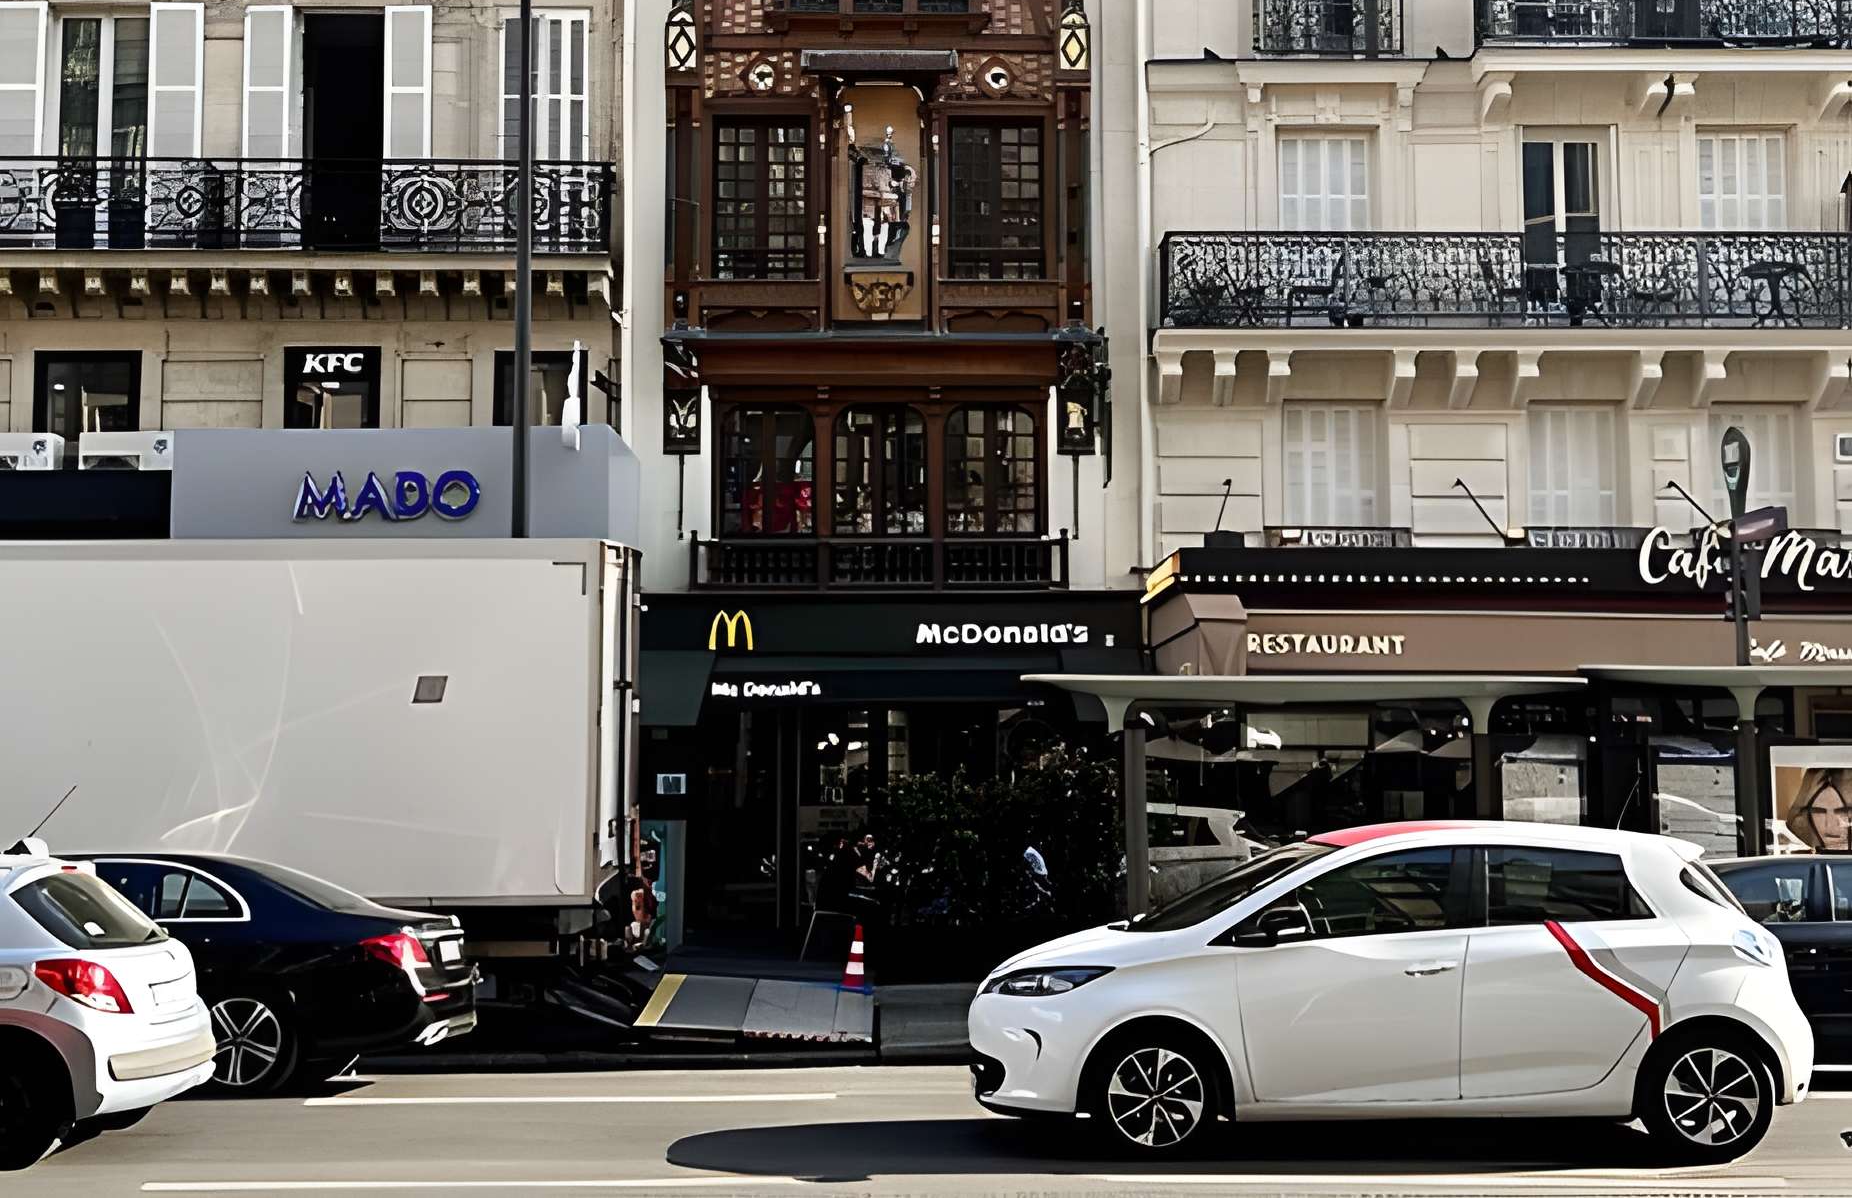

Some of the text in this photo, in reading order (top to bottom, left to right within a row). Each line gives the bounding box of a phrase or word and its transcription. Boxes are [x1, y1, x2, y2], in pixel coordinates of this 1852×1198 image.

[302, 353, 364, 373] KFC
[292, 470, 481, 522] MADO
[916, 623, 1089, 644] McDonald's
[1247, 633, 1406, 655] RESTAURANT
